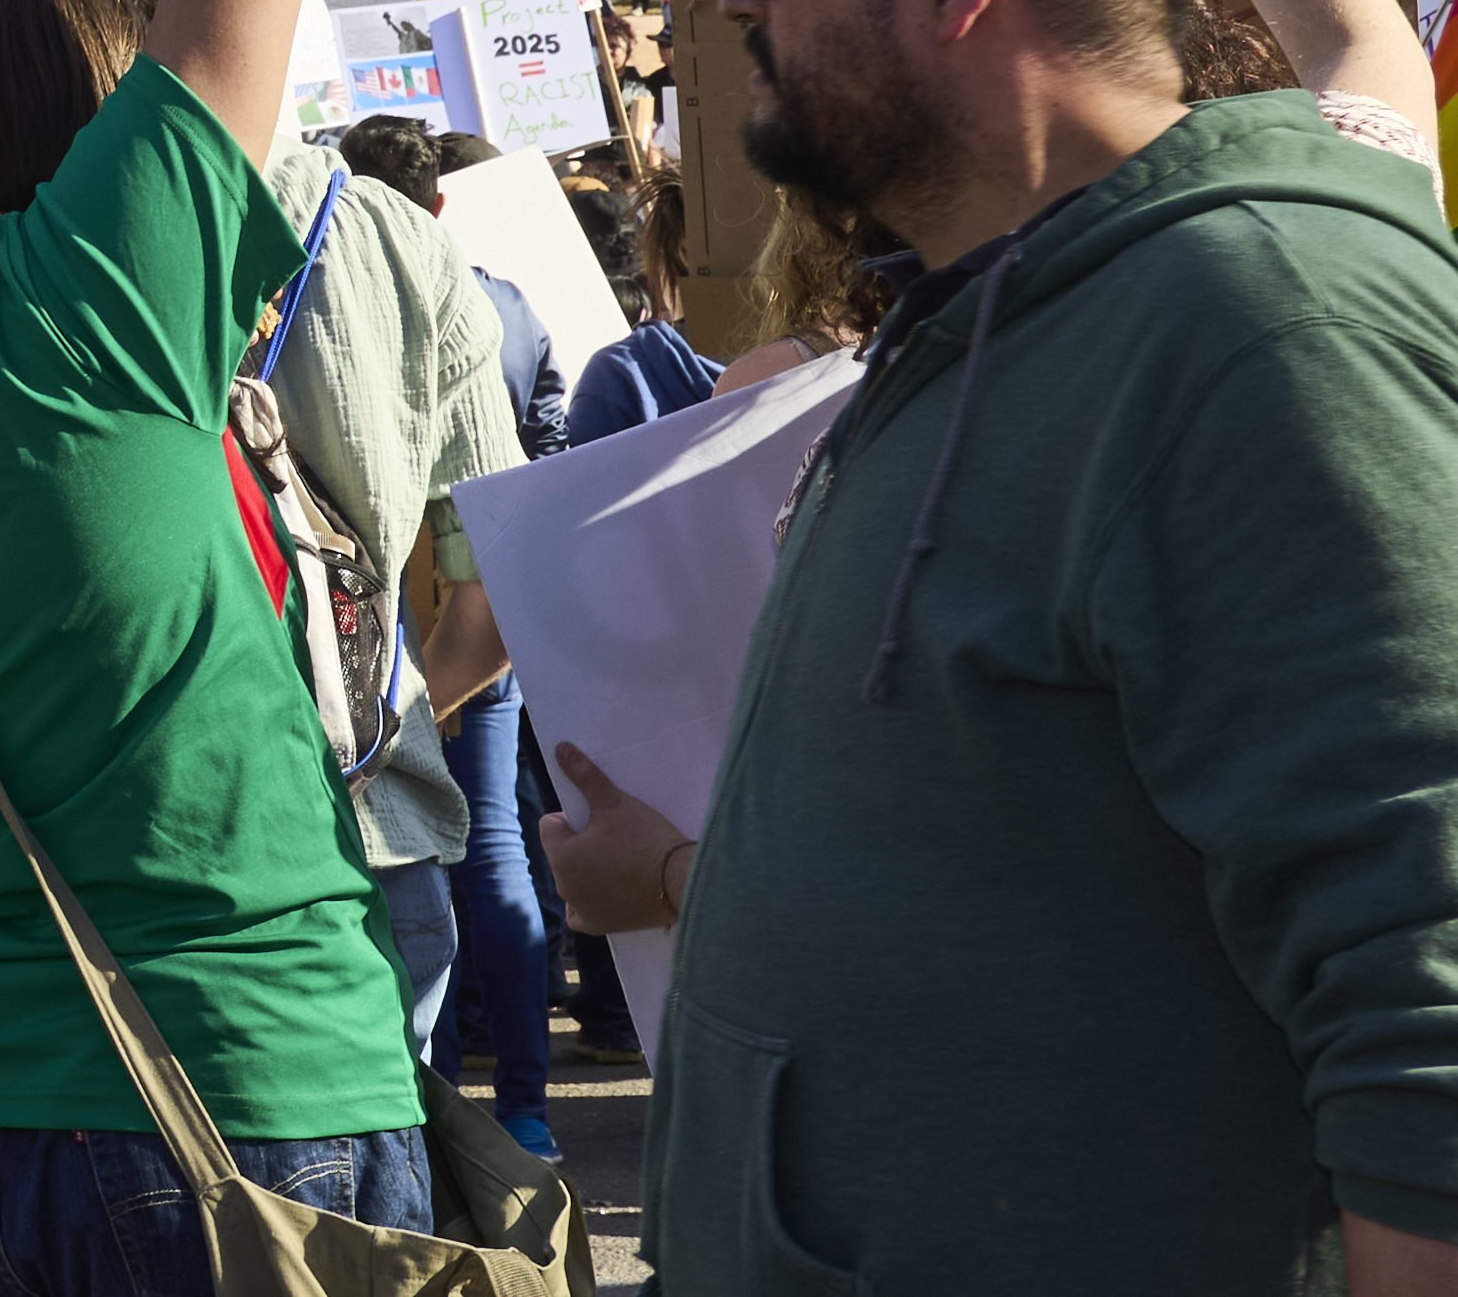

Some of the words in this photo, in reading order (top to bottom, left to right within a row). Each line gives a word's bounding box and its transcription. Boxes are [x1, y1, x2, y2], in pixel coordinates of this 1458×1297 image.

[493, 33, 561, 58] 2025
[499, 70, 598, 108] RACIST
[503, 112, 574, 144] Agenda
